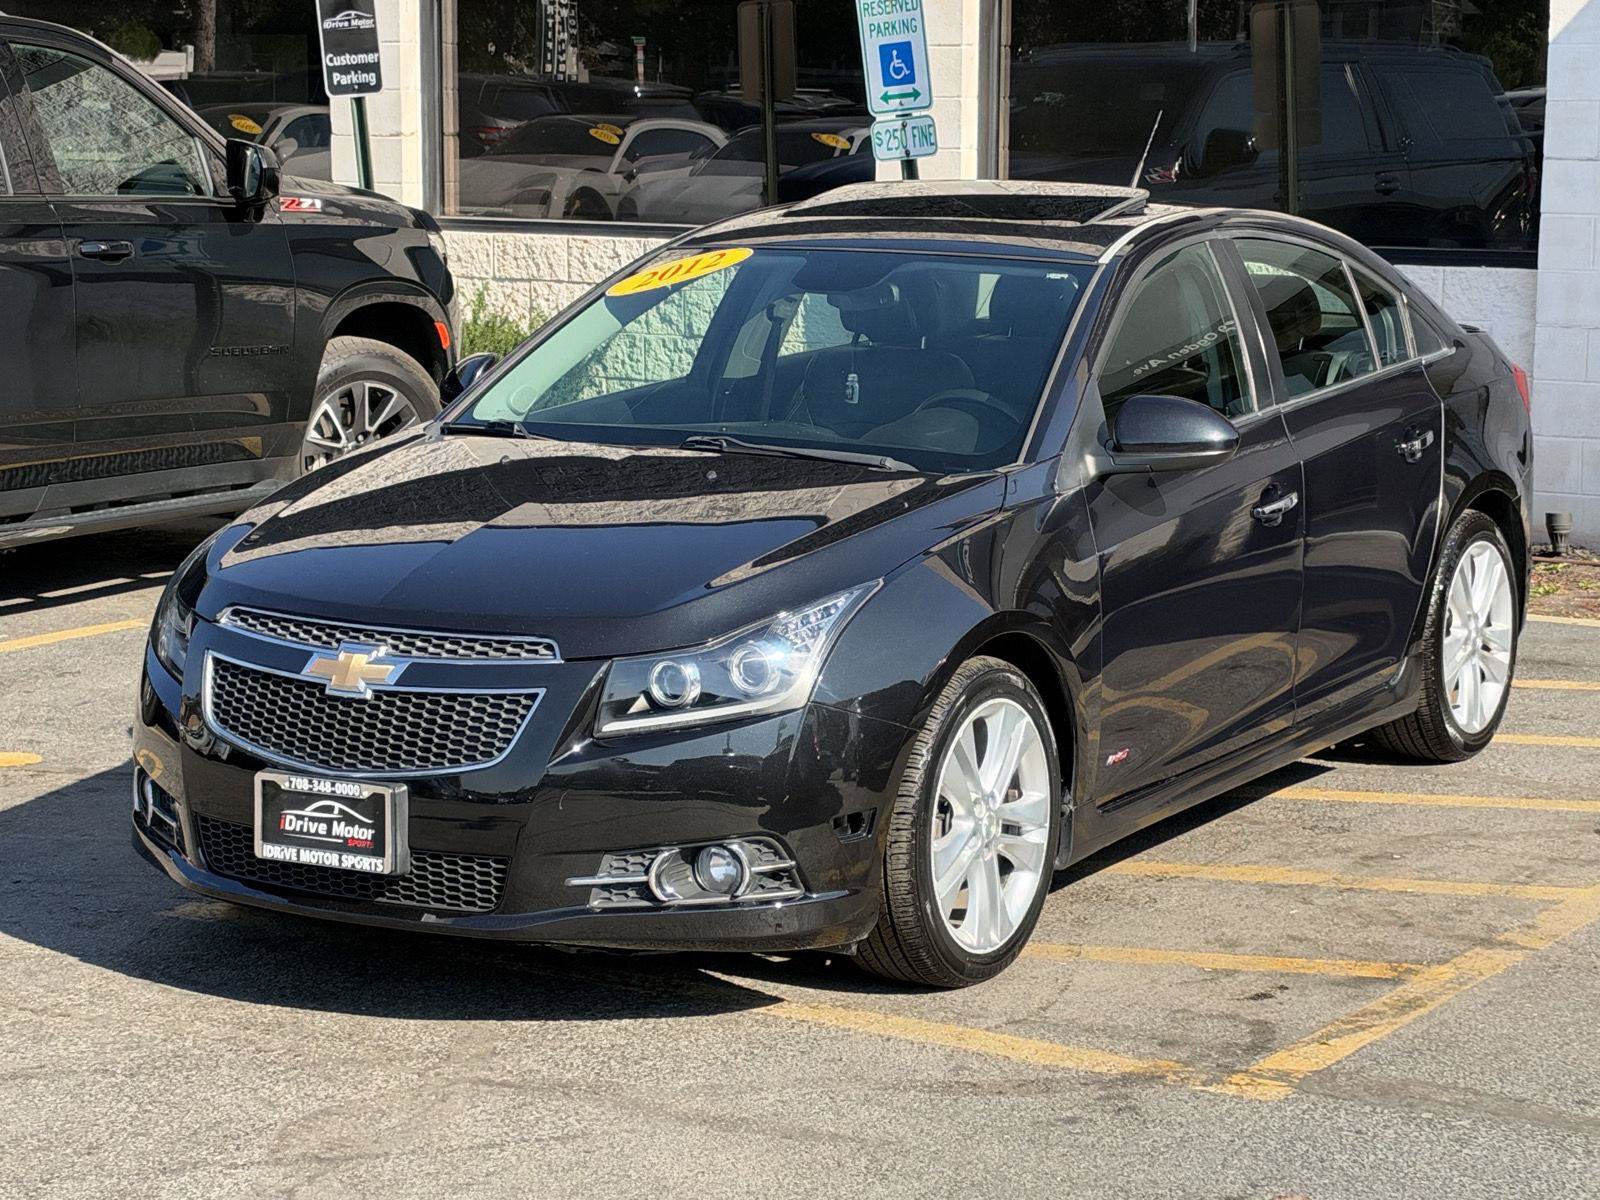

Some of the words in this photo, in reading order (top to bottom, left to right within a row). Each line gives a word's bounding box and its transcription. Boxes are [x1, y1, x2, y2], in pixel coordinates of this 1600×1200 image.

[863, 0, 918, 17] RESERVED
[351, 18, 374, 26] Motor
[868, 18, 918, 39] PARKING
[326, 52, 379, 66] Customer
[333, 71, 377, 85] Parking
[911, 123, 935, 149] FINE
[280, 197, 322, 212] Z71
[632, 252, 727, 289] 2012
[290, 777, 360, 796] 708-348-0000
[279, 813, 328, 835] iDrive
[331, 820, 375, 841] Motor
[300, 850, 339, 867] MOTOR
[341, 854, 384, 873] SPORTS
